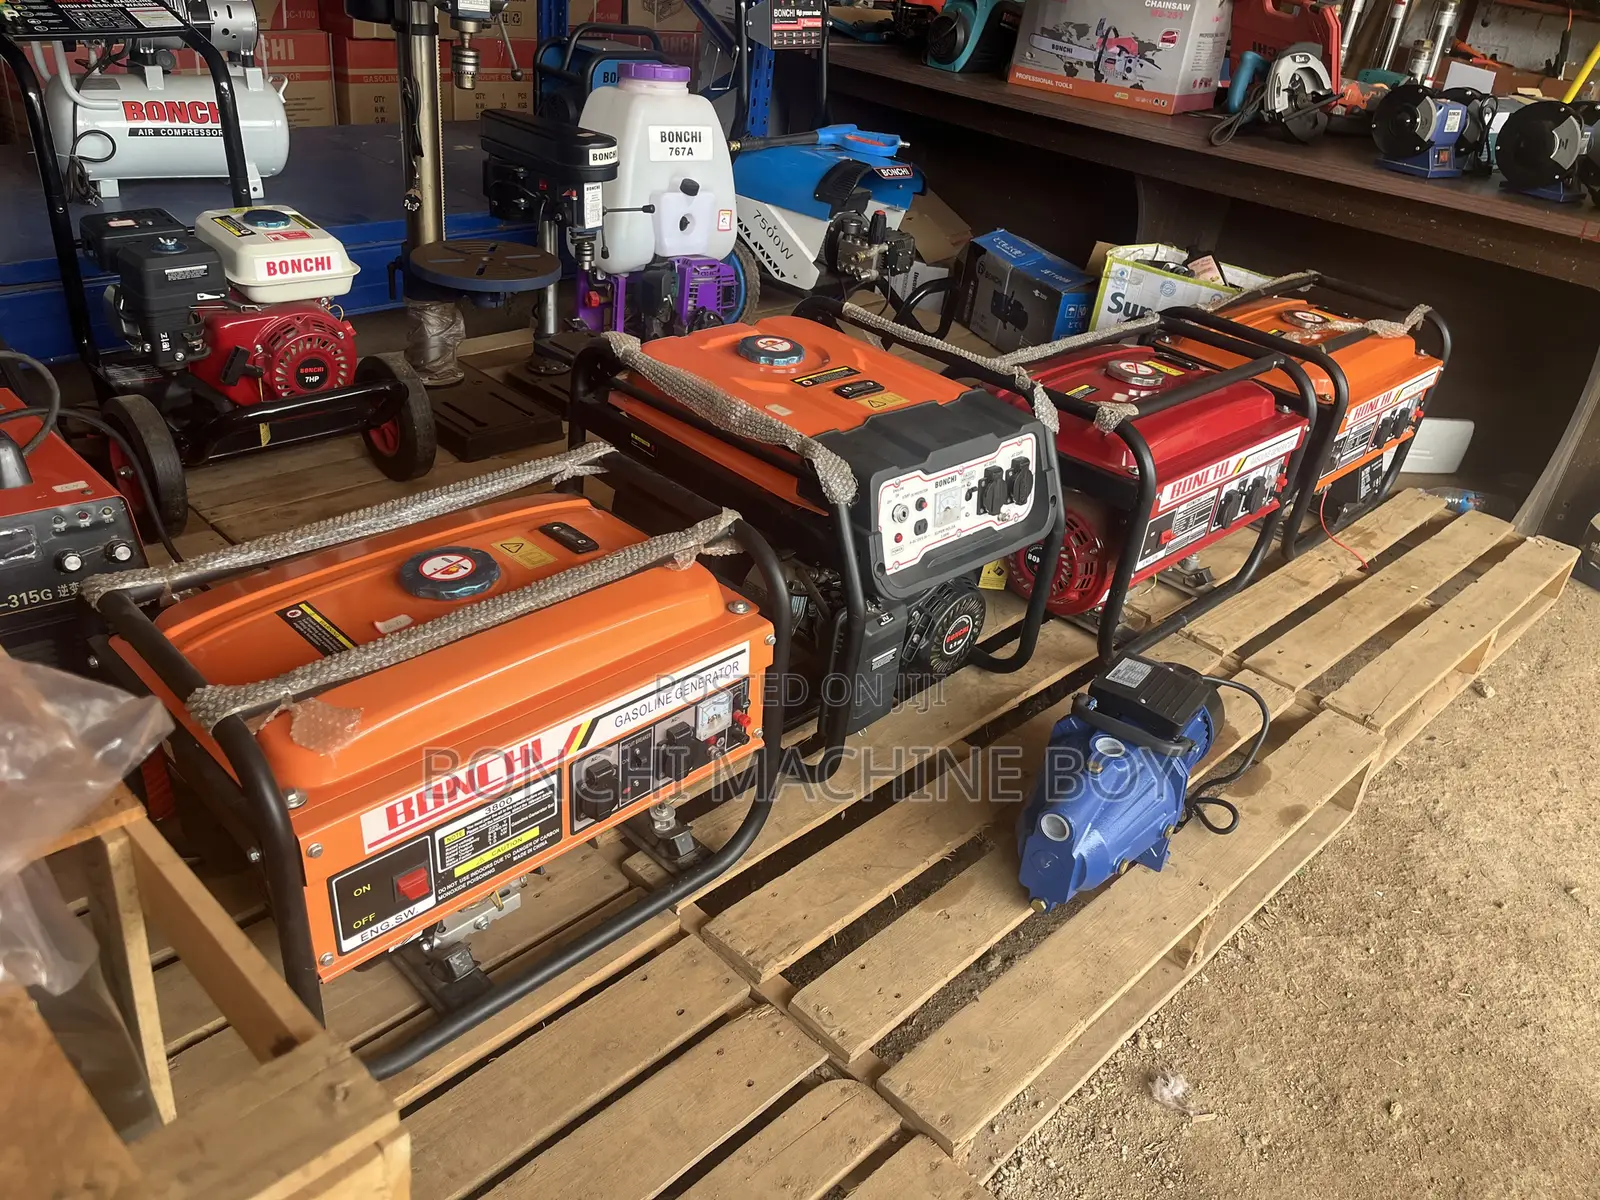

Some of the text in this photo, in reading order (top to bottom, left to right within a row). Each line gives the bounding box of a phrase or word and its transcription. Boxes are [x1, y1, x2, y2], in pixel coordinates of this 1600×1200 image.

[774, 9, 795, 17] BONCHI
[1145, 0, 1191, 11] CHAINSAW
[1052, 43, 1073, 54] BONCHI
[363, 75, 399, 83] GASOLIN
[1015, 72, 1073, 90] PROFESSIONAL TOOLS
[122, 101, 220, 124] BONCH
[660, 131, 702, 143] BONCHI
[669, 147, 694, 156] 767A
[881, 167, 910, 177] BONCHI
[753, 209, 794, 260] 7500W
[266, 256, 332, 277] BONCHI
[305, 375, 320, 383] 7HP
[935, 475, 957, 489] BONCHI
[1170, 461, 1230, 500] BONCHI
[614, 660, 740, 728] GASOLINE GENERATOR
[386, 738, 543, 831] BONCHI
[485, 796, 513, 815] 3800
[446, 831, 463, 843] NOTE
[491, 837, 523, 857] CAUTION
[512, 850, 527, 861] MADE
[533, 840, 548, 851] CHINA
[438, 887, 447, 895] DO
[447, 881, 458, 890] NOT
[459, 874, 470, 883] USE
[470, 862, 493, 878] INDOORS
[493, 857, 504, 866] DUE
[512, 842, 533, 856] DANGER
[540, 828, 560, 842] CARBON
[353, 884, 371, 897] ON
[437, 867, 496, 900] MONOXIDE POISONING
[353, 912, 376, 929] OFF
[361, 907, 419, 941] ENG.SW.
